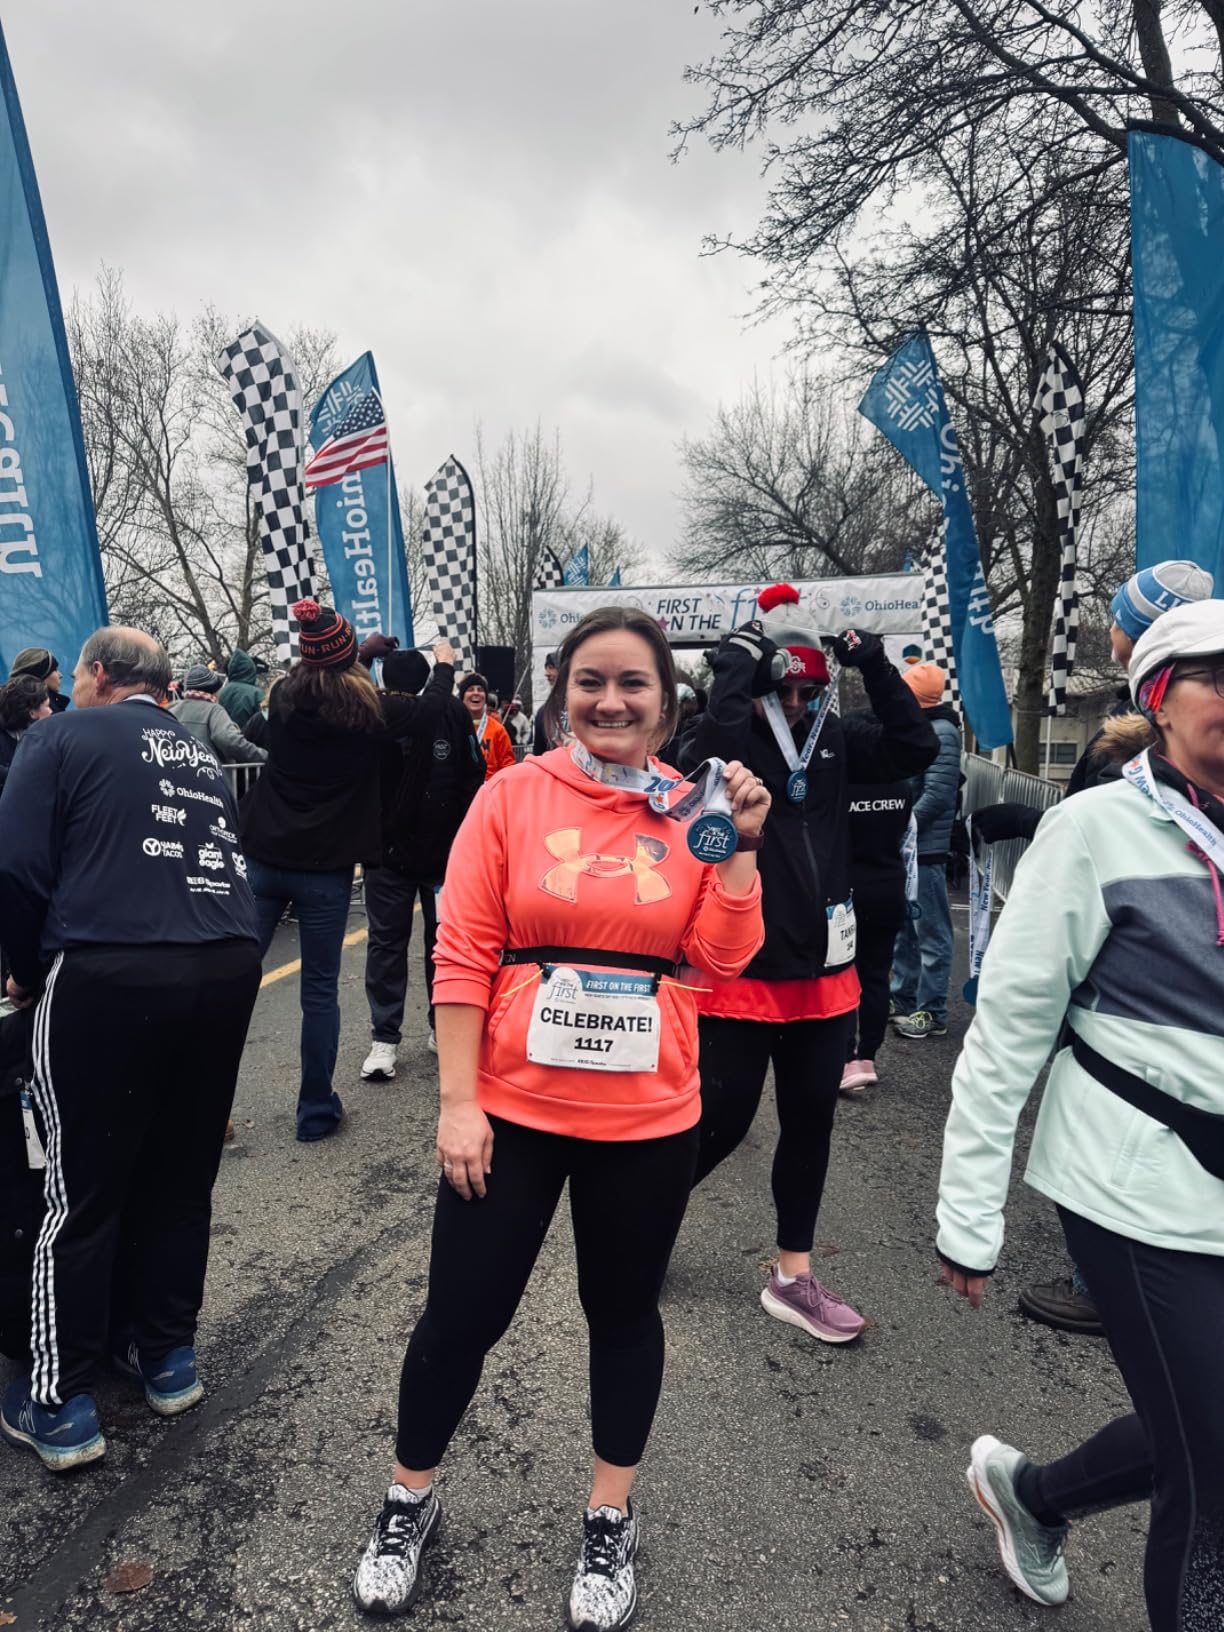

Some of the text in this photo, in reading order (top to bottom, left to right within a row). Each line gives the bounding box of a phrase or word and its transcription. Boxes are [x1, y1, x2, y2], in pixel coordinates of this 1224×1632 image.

[656, 597, 702, 614] FIRST
[864, 599, 919, 611] OhioHea
[689, 614, 721, 630] THE
[176, 787, 224, 808] OhioHealth
[848, 798, 906, 812] ACE CREW
[151, 804, 178, 816] FLEET
[155, 812, 177, 825] FEET
[586, 980, 652, 993] FIRST ON THE FIRST
[540, 1007, 652, 1033] CELEBRATE!
[574, 1037, 614, 1053] 1117
